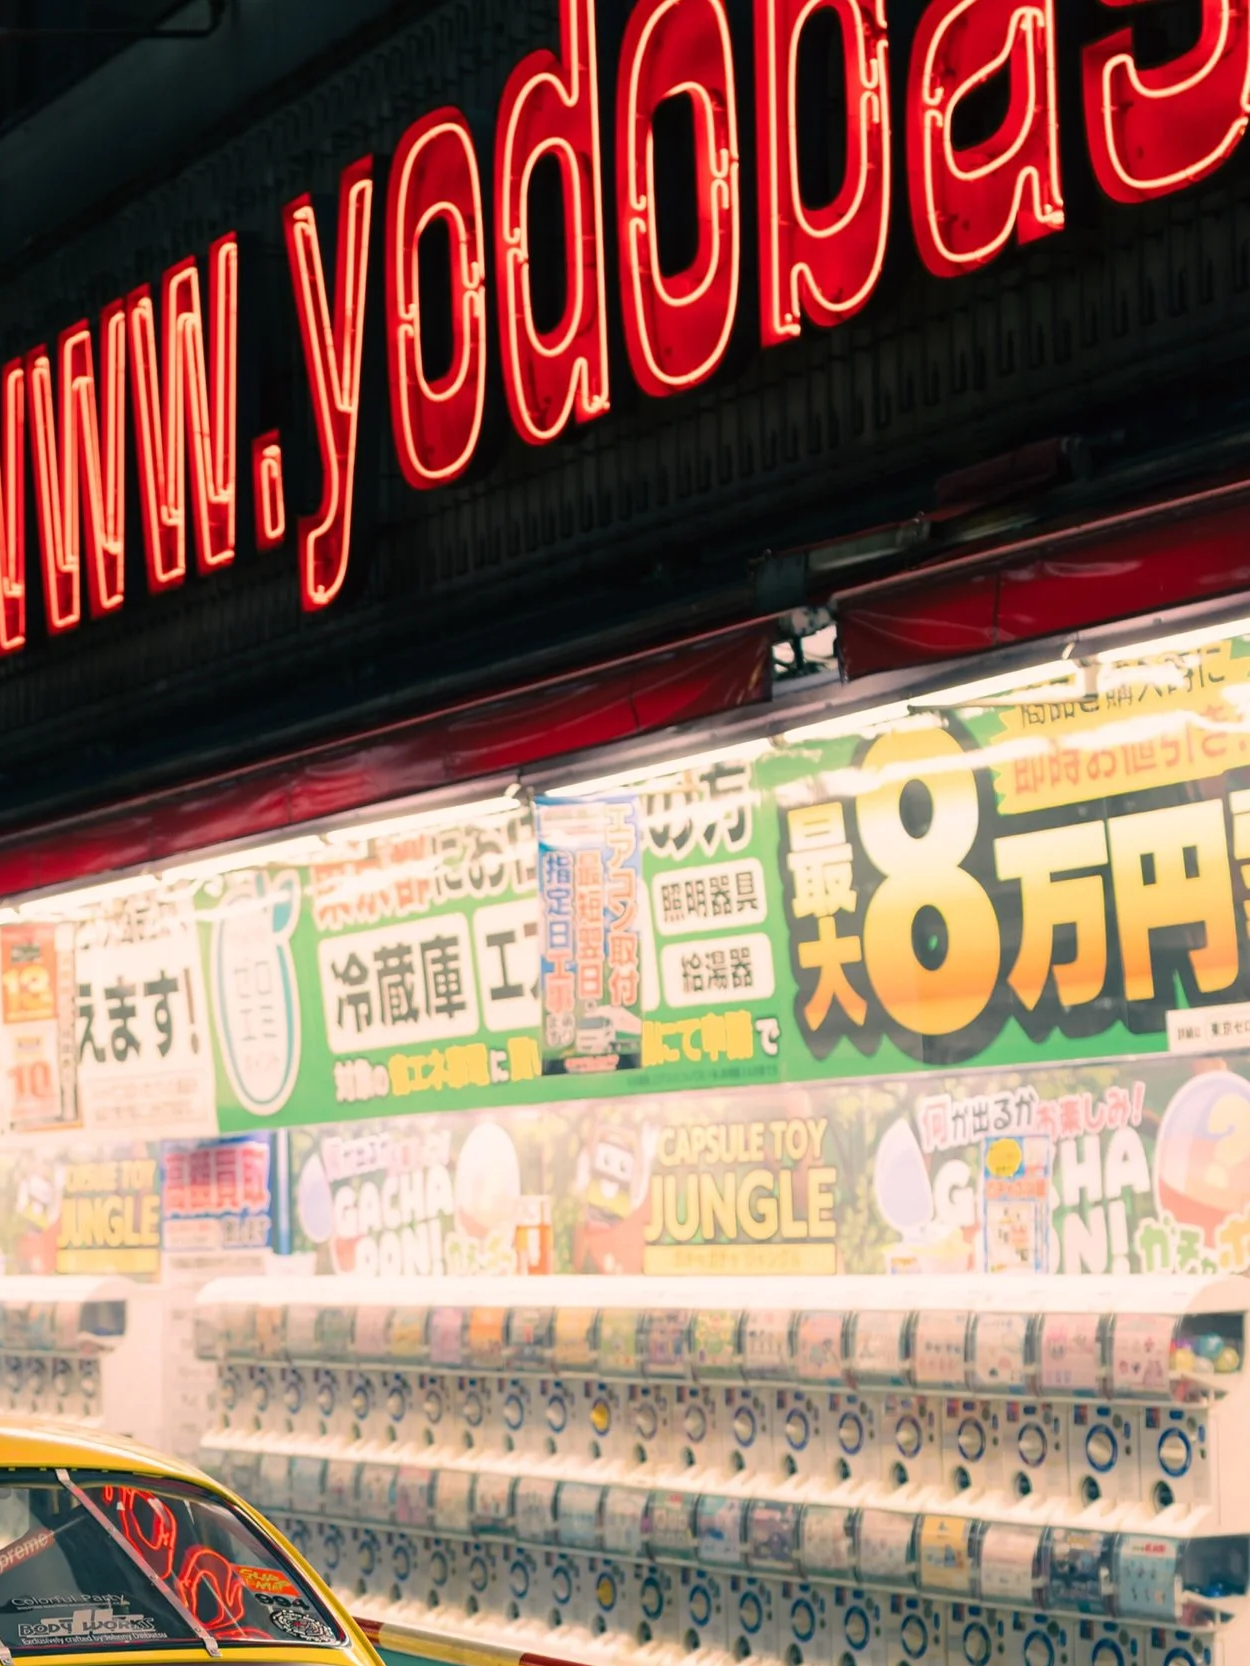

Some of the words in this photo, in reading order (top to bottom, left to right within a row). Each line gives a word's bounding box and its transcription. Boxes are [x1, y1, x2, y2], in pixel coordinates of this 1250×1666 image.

[661, 870, 758, 922] 照明器具
[330, 934, 467, 1033] 冷蔵庫
[485, 922, 538, 1001] エ
[658, 1121, 764, 1166] CAPSULE
[769, 1118, 828, 1161] TOY
[643, 1167, 836, 1243] JUNGLE
[11, 1594, 78, 1606] Colorful
